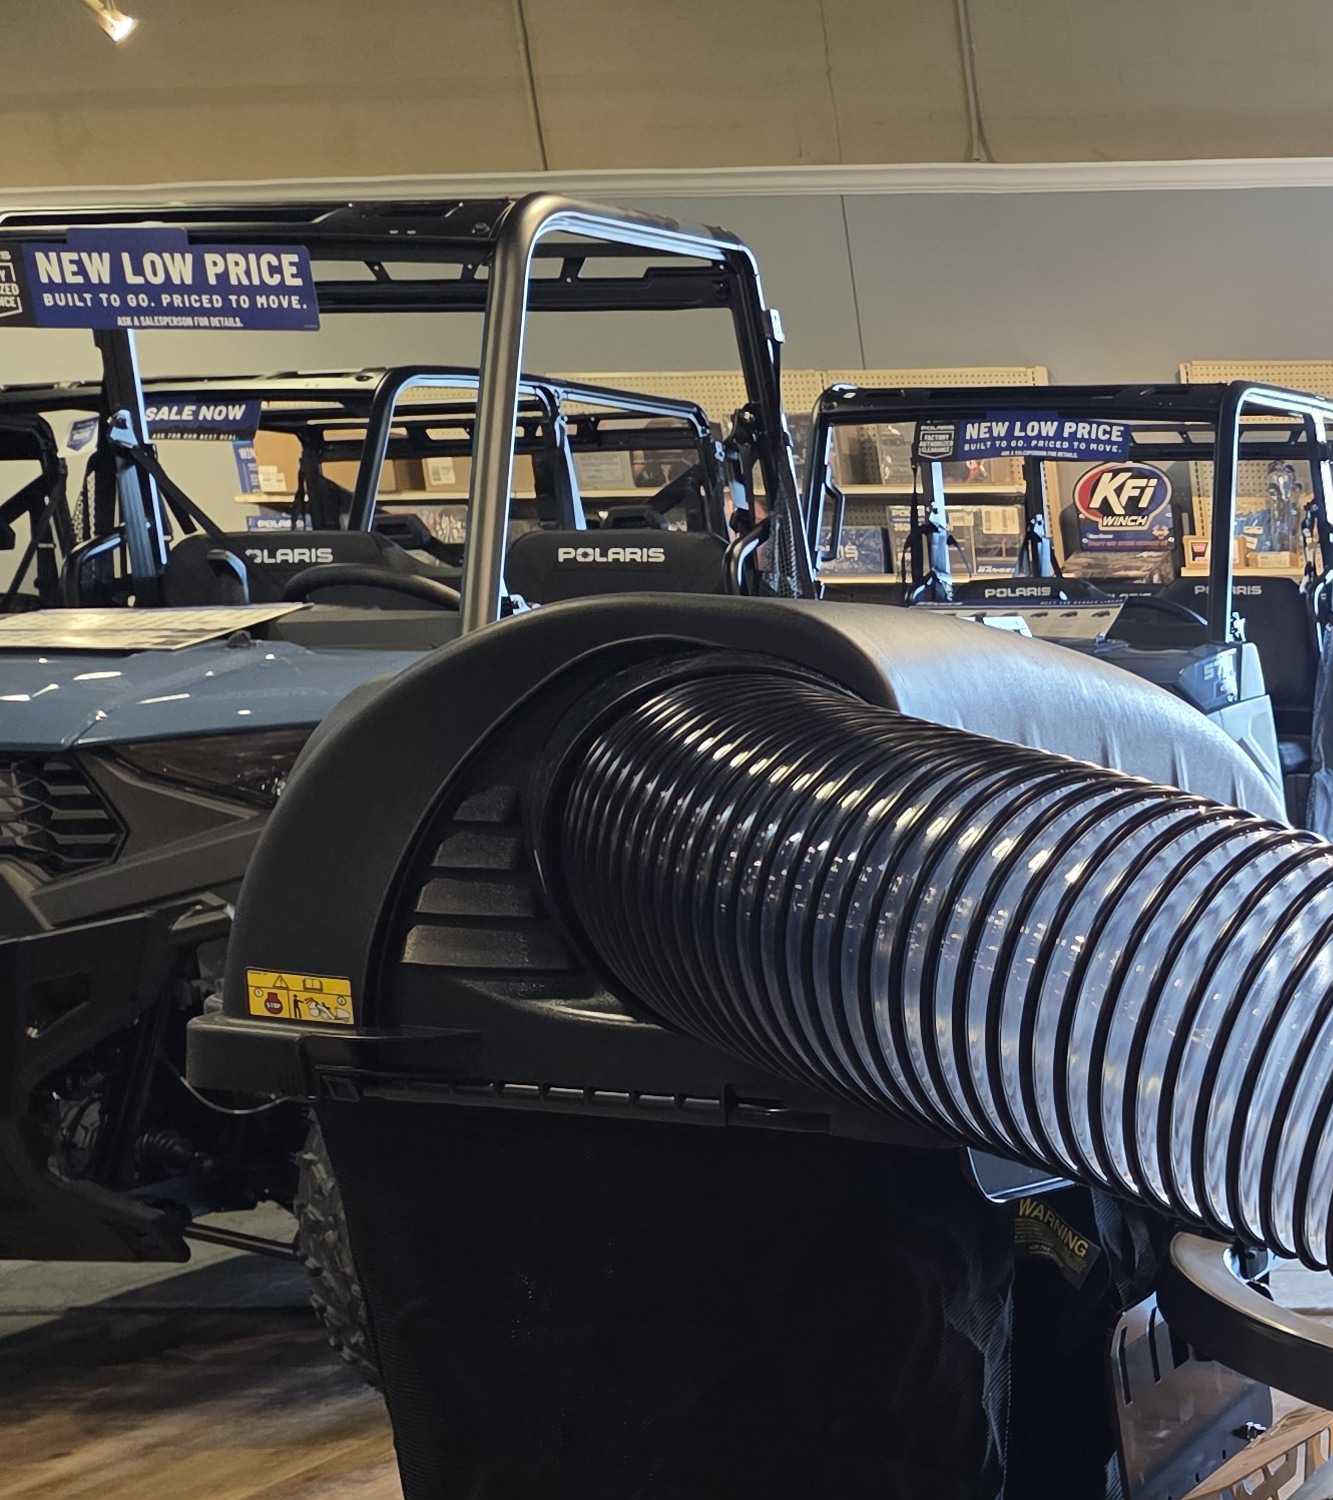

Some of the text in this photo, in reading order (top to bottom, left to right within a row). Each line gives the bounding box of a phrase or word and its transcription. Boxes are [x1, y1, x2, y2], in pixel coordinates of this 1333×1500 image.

[34, 251, 111, 284] NEW
[121, 252, 194, 285] LOW
[204, 253, 303, 286] PRICE
[42, 292, 308, 309] BUILT TO GO. PRICED TO MOVE.
[145, 404, 246, 421] SALE NOW
[965, 421, 1125, 442] NEW LOW PRICE
[964, 441, 992, 450] BUILT
[1031, 440, 1070, 448] PRICED
[1101, 515, 1148, 527] WINCH
[245, 548, 333, 564] OLARIS
[558, 547, 665, 563] POLARIS
[985, 586, 1051, 598] POLARIS
[1019, 1198, 1089, 1257] WARNING
